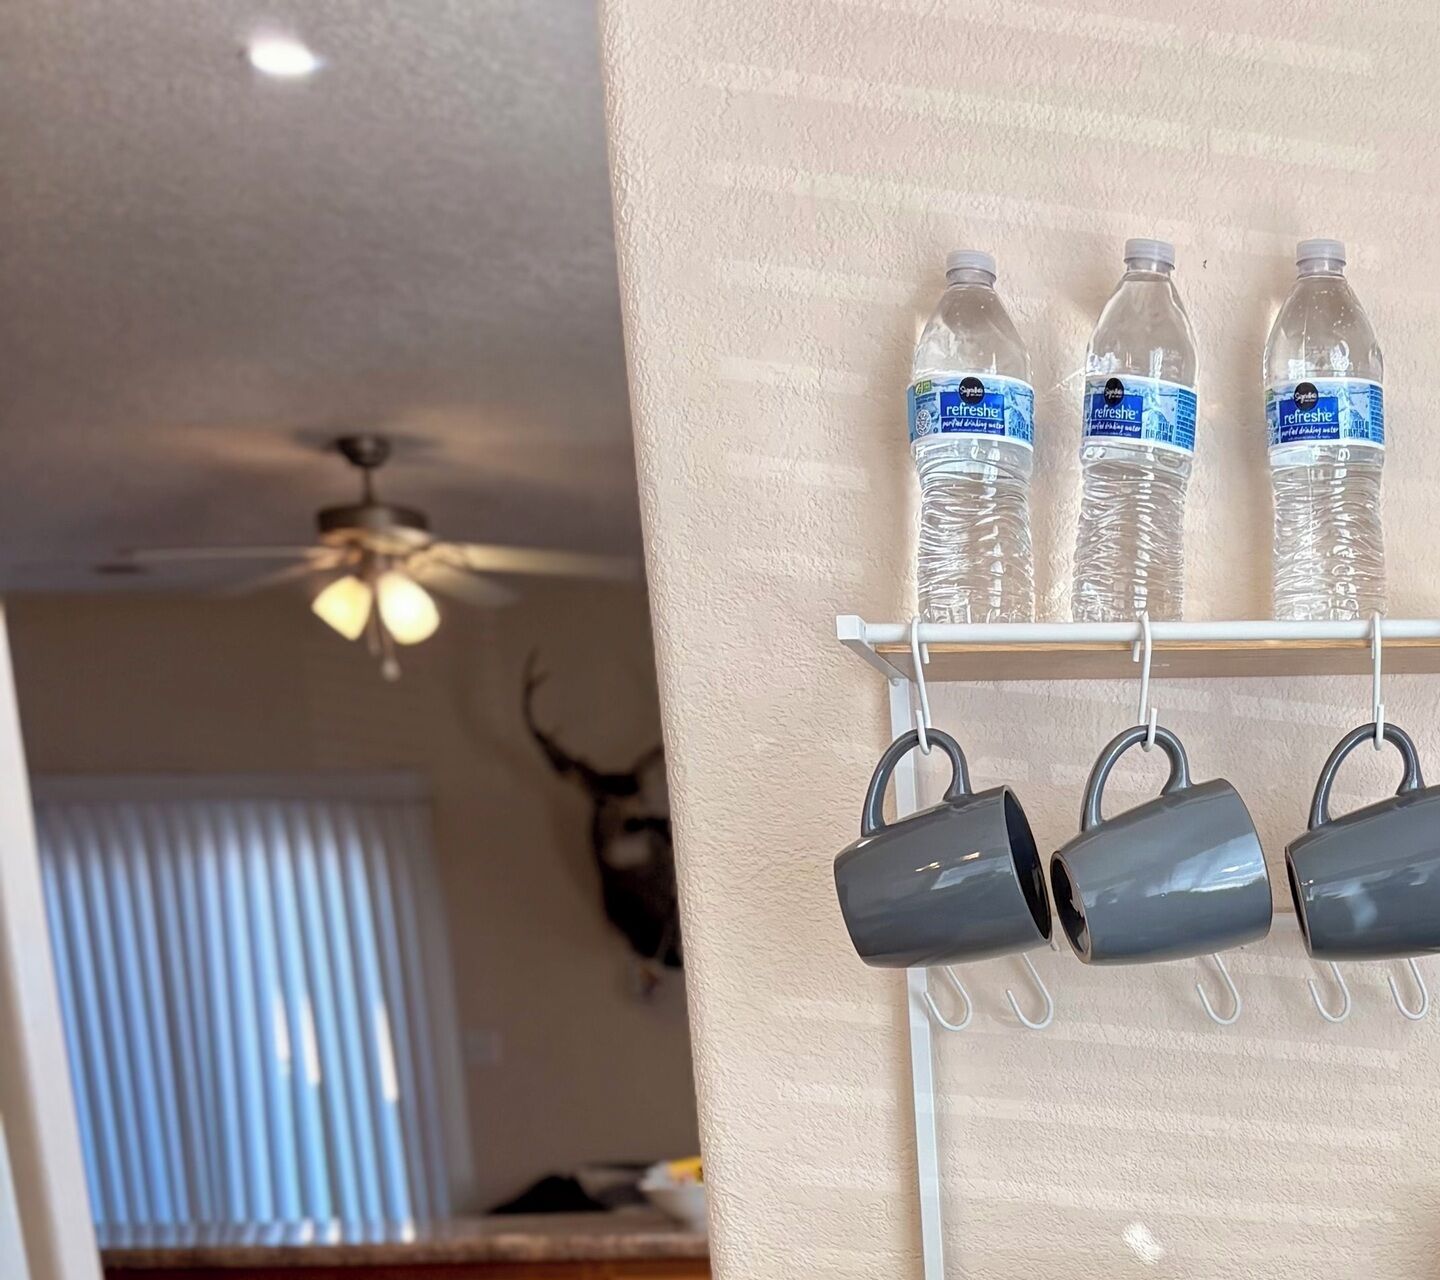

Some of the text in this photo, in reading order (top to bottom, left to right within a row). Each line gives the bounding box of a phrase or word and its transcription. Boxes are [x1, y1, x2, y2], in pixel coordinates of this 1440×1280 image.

[964, 417, 987, 430] drinking
[988, 422, 1005, 430] water
[1125, 424, 1141, 432] water
